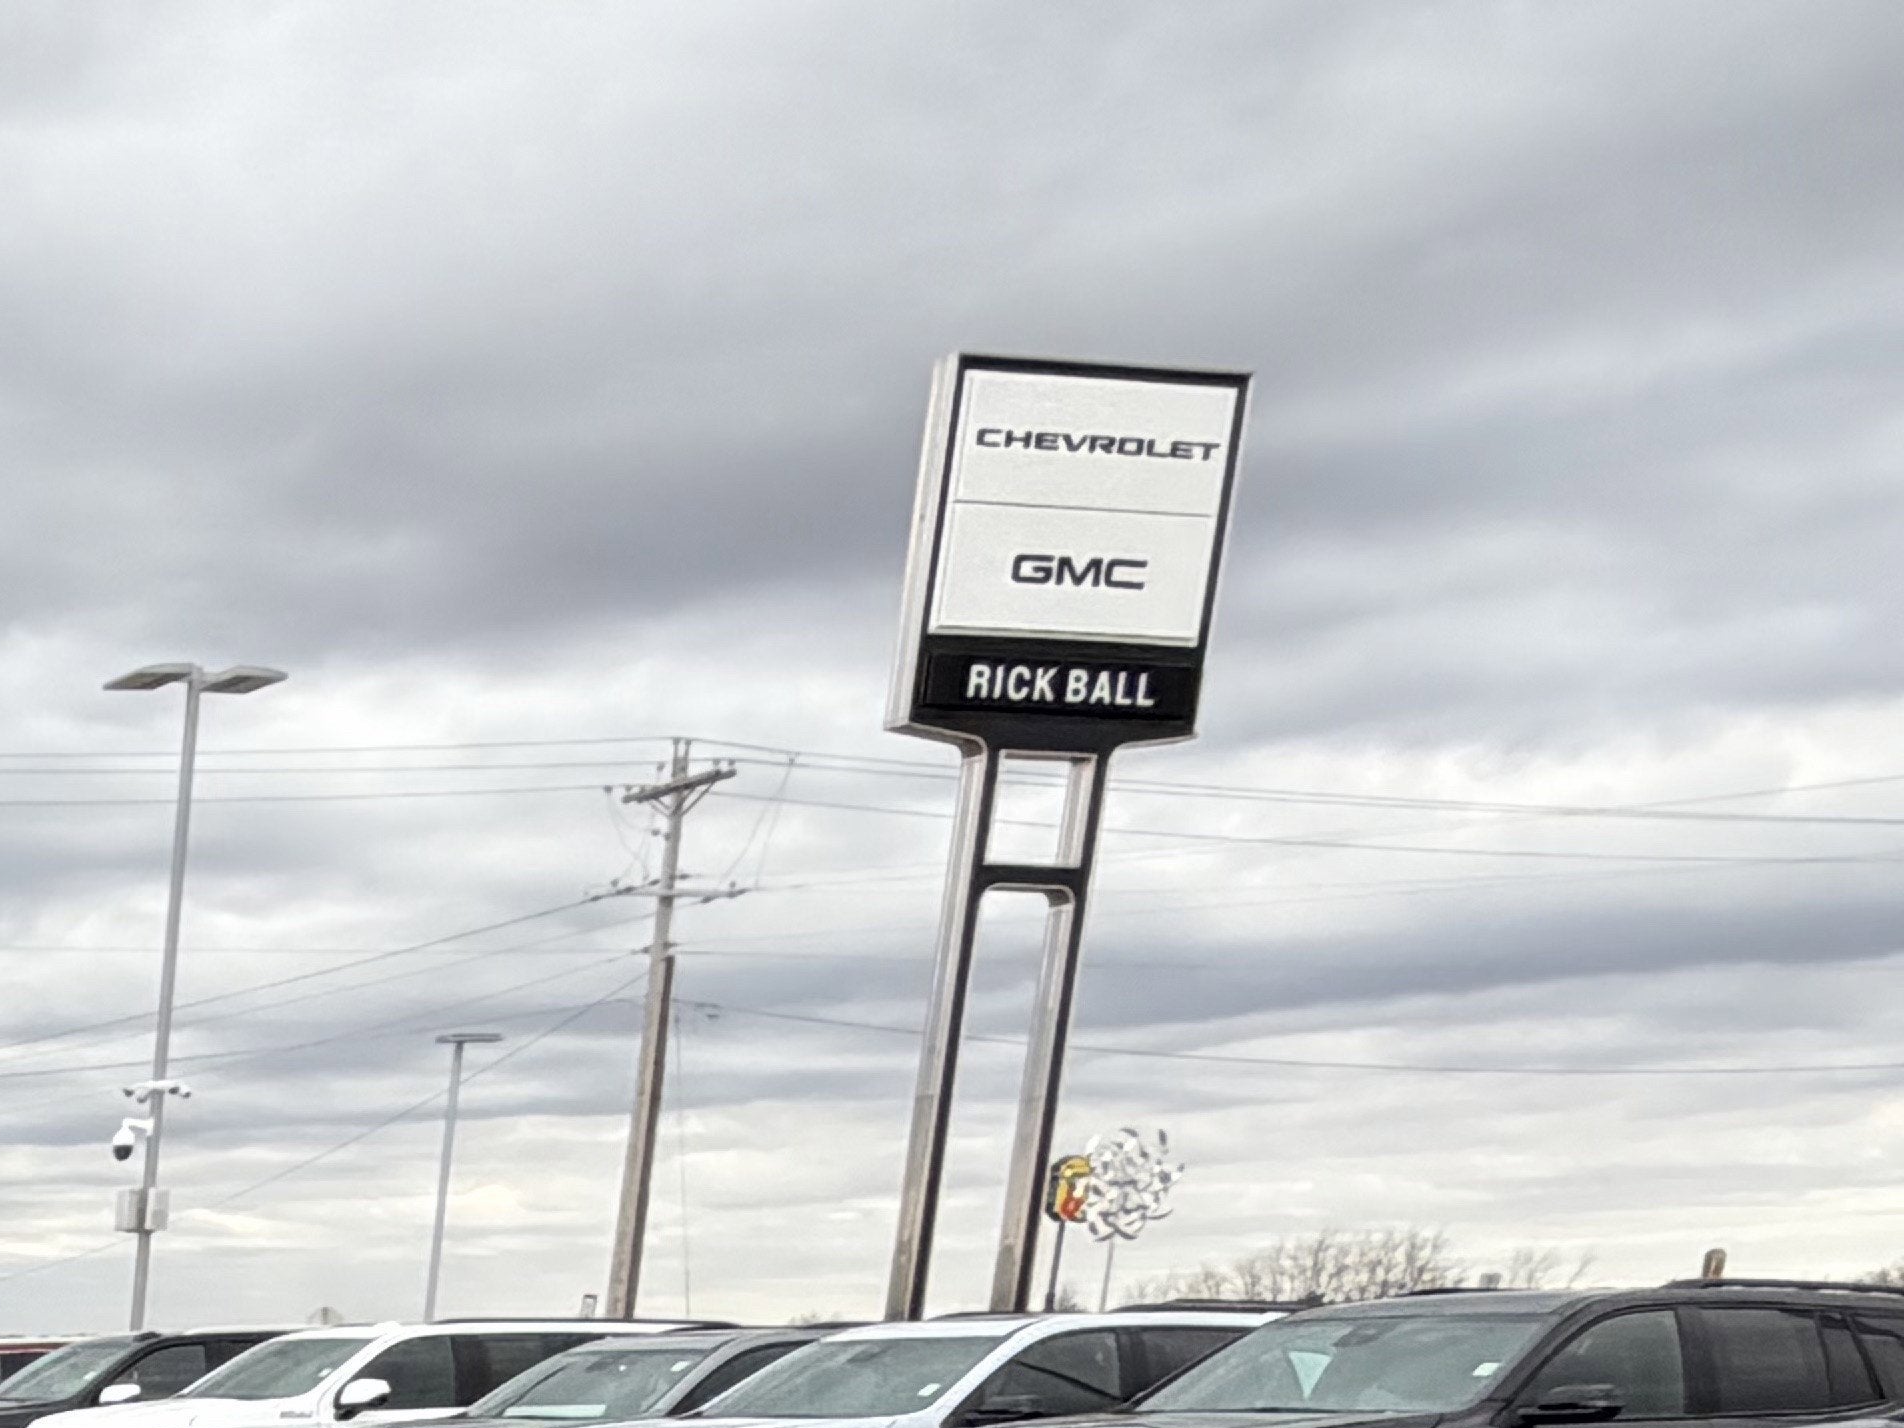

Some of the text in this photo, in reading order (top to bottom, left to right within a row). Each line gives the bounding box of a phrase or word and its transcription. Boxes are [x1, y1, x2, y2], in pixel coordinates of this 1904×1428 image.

[976, 427, 1222, 462] CHEVROLET
[1010, 554, 1148, 591] GMC
[966, 664, 1156, 708] RICK BALL
